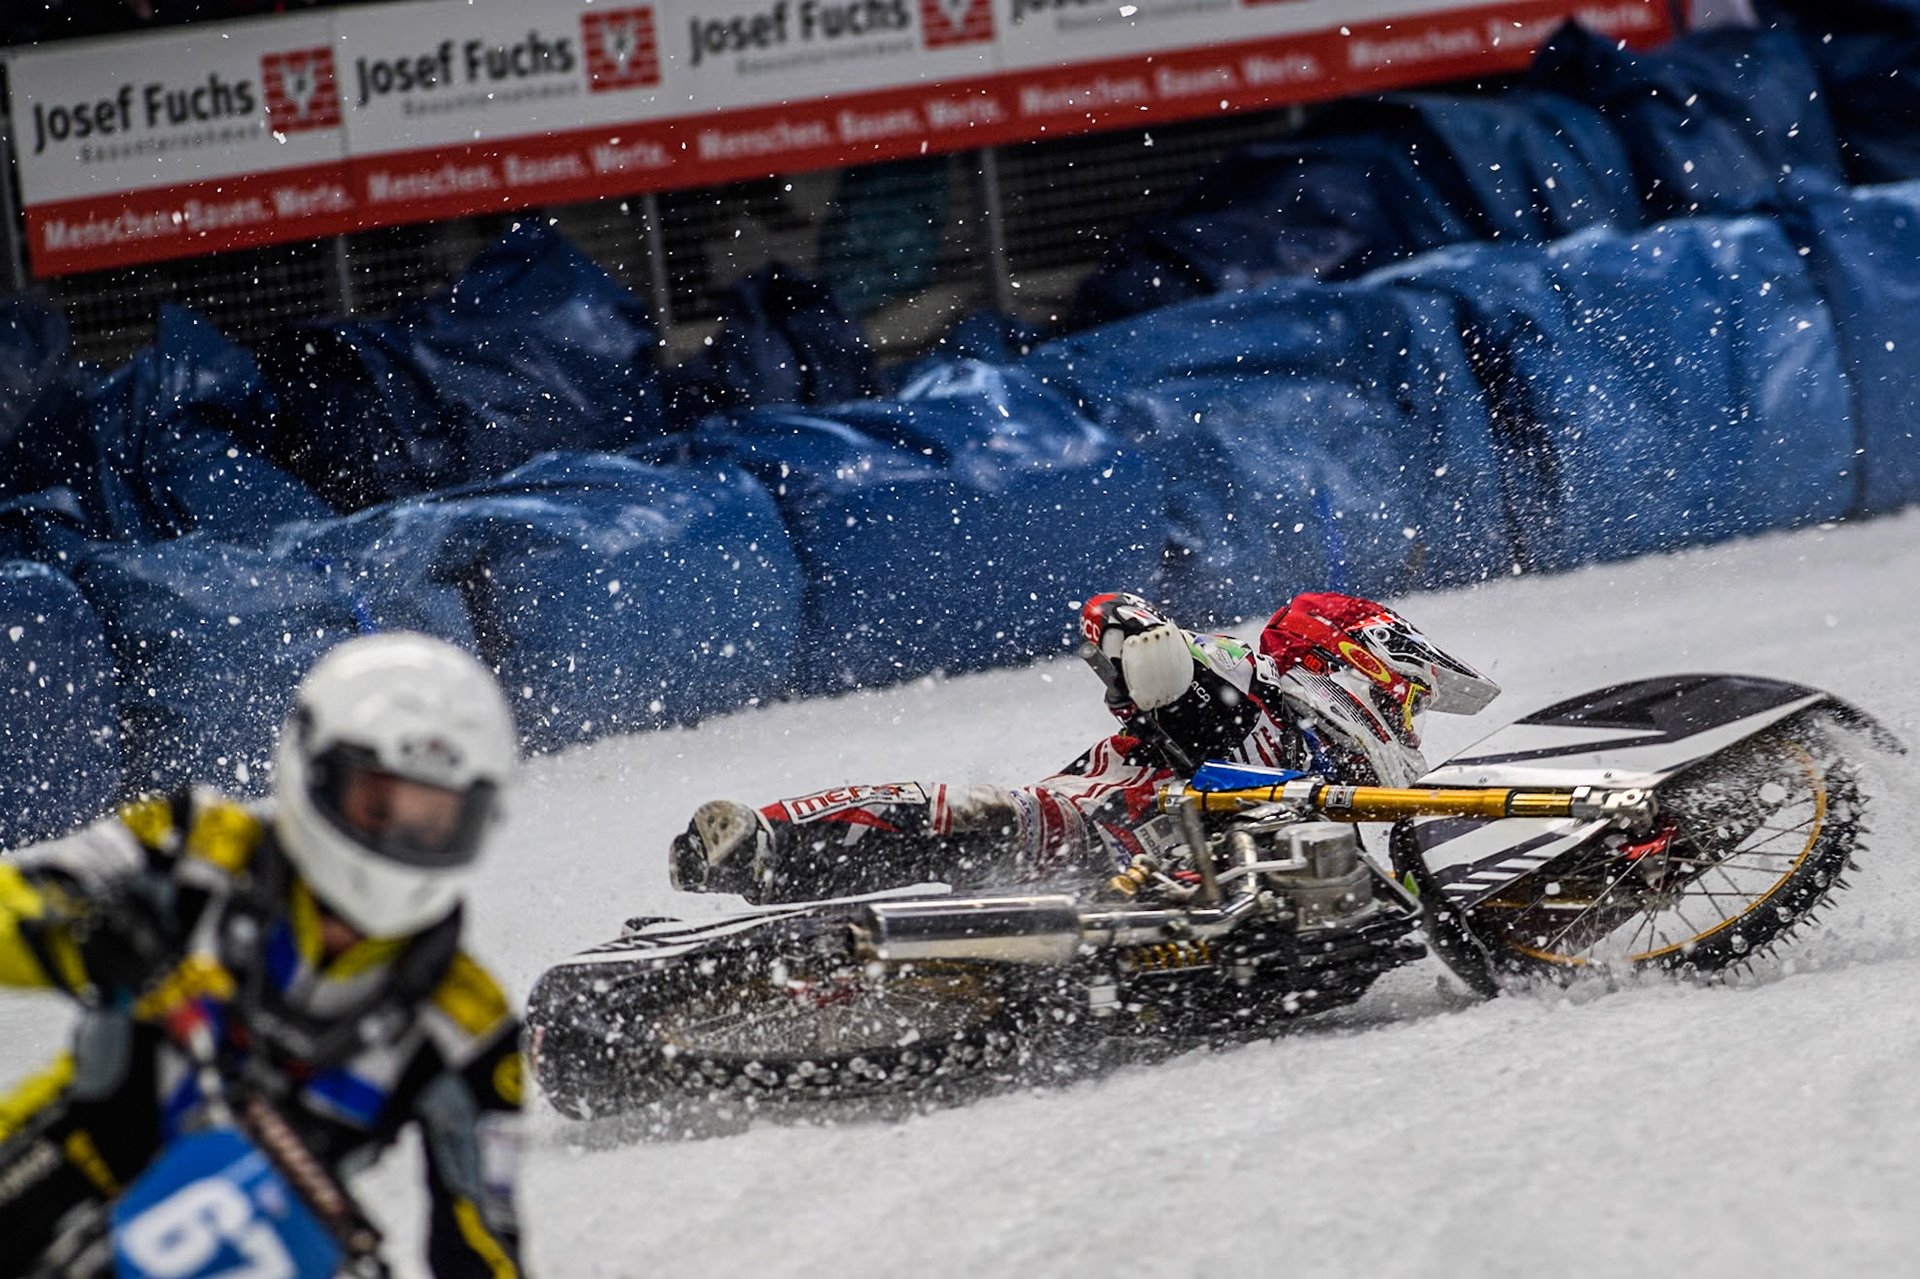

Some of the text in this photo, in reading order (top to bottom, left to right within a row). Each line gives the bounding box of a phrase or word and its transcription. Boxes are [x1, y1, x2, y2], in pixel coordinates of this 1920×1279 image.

[355, 28, 575, 107] Josef Fuchs
[690, 0, 912, 67] Josef Fuchs
[33, 72, 256, 154] Josef Fuchs
